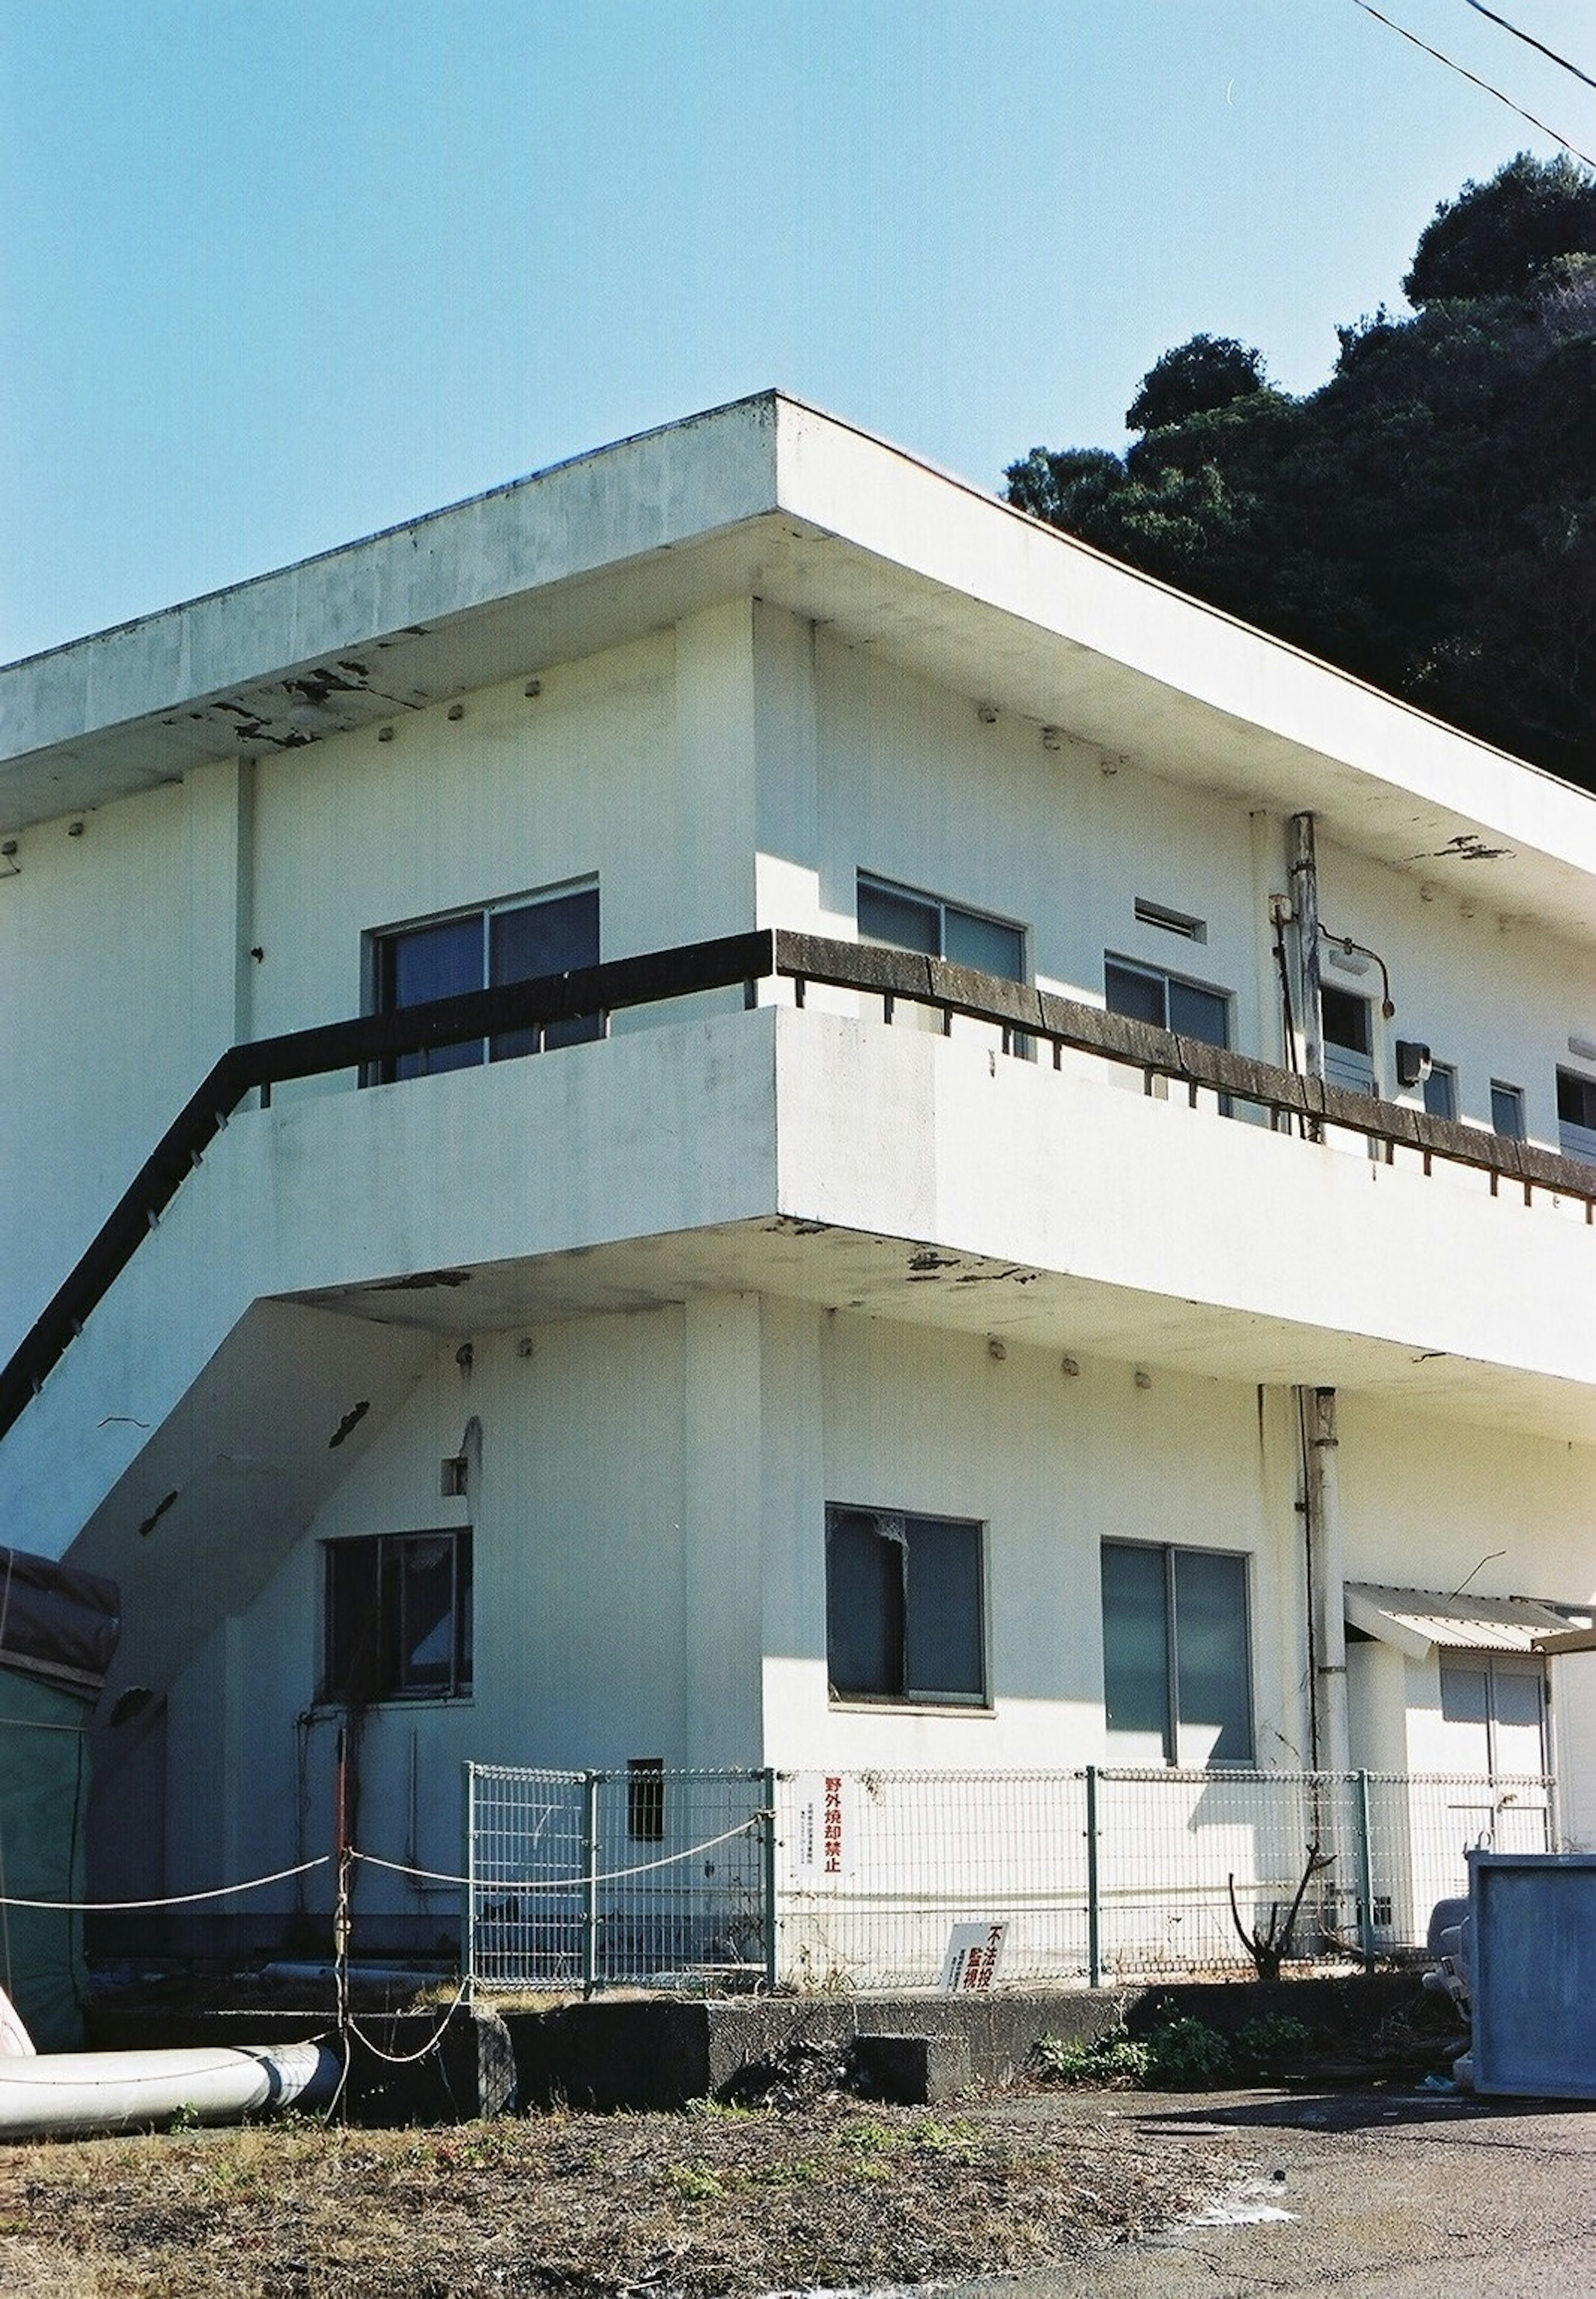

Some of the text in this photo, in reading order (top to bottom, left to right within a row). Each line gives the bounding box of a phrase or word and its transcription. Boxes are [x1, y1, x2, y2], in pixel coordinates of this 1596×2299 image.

[824, 1777, 842, 1873] 野外焼却禁止
[963, 1947, 983, 1993] 監視
[976, 1926, 1003, 1992] 不法投
